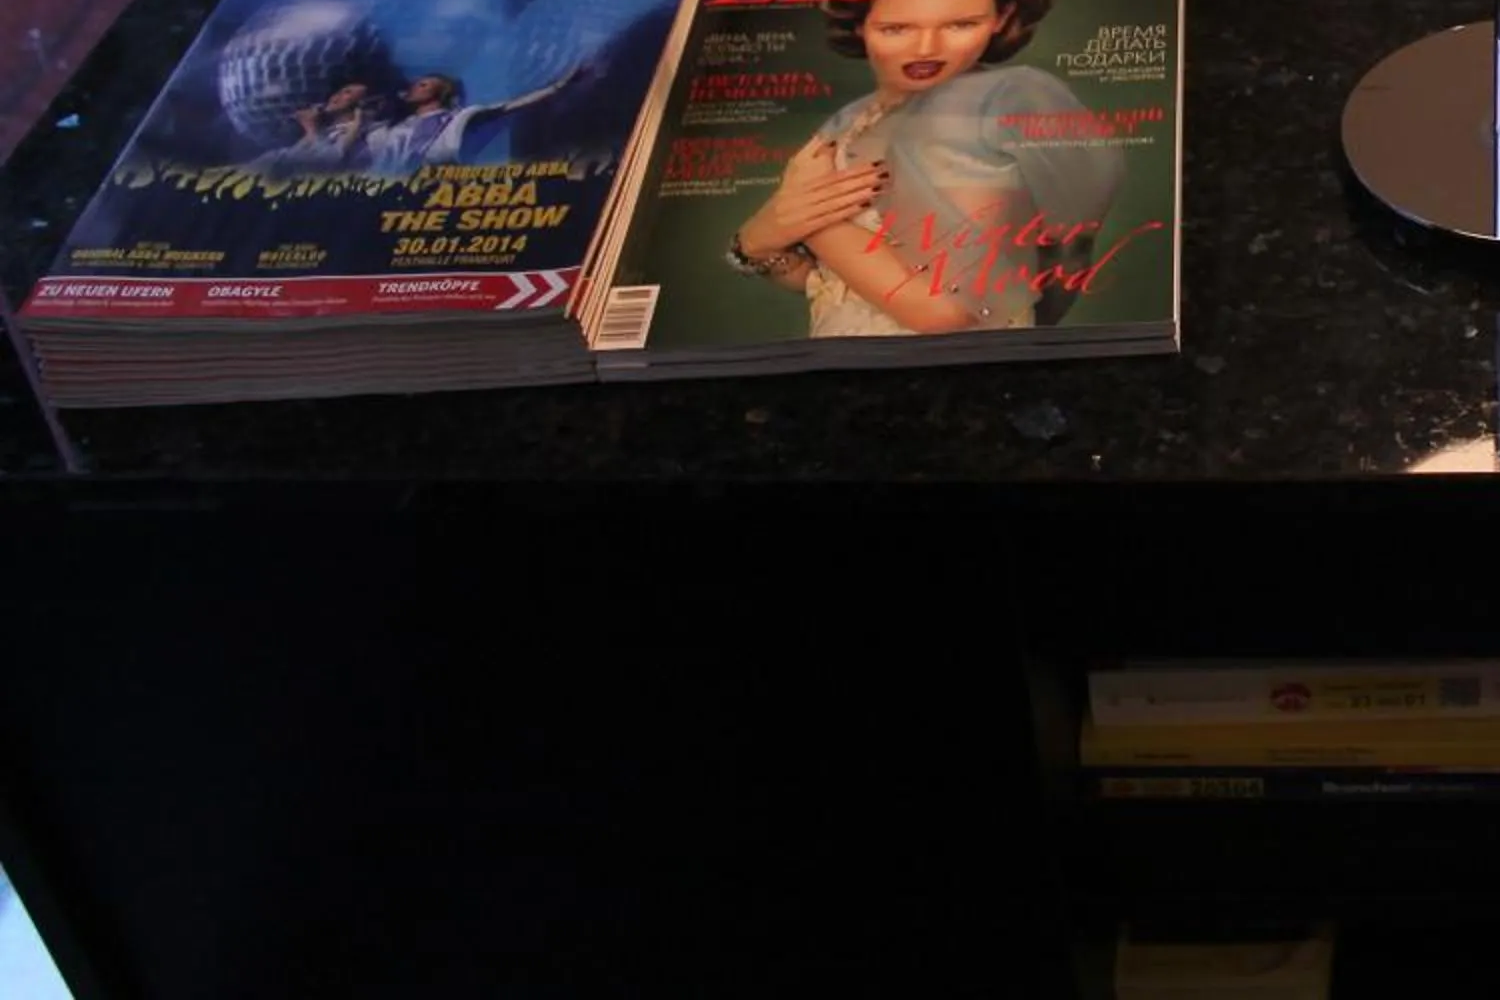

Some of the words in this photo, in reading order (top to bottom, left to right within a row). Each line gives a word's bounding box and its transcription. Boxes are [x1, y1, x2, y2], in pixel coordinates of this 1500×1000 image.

[1097, 23, 1167, 40] ВРЕМЯ
[1083, 37, 1167, 54] ДЕЛАТЬ
[1055, 50, 1166, 68] ПОДАРКИ
[525, 160, 570, 177] ABBA
[423, 180, 538, 208] ABBA
[380, 209, 450, 233] THE
[456, 204, 571, 230] SHOW
[393, 234, 528, 256] 30.01.2014
[38, 284, 62, 298] ZU
[63, 284, 119, 298] NEUEN
[120, 284, 176, 298] UFERN
[377, 278, 481, 294] TRENDKÖPFE
